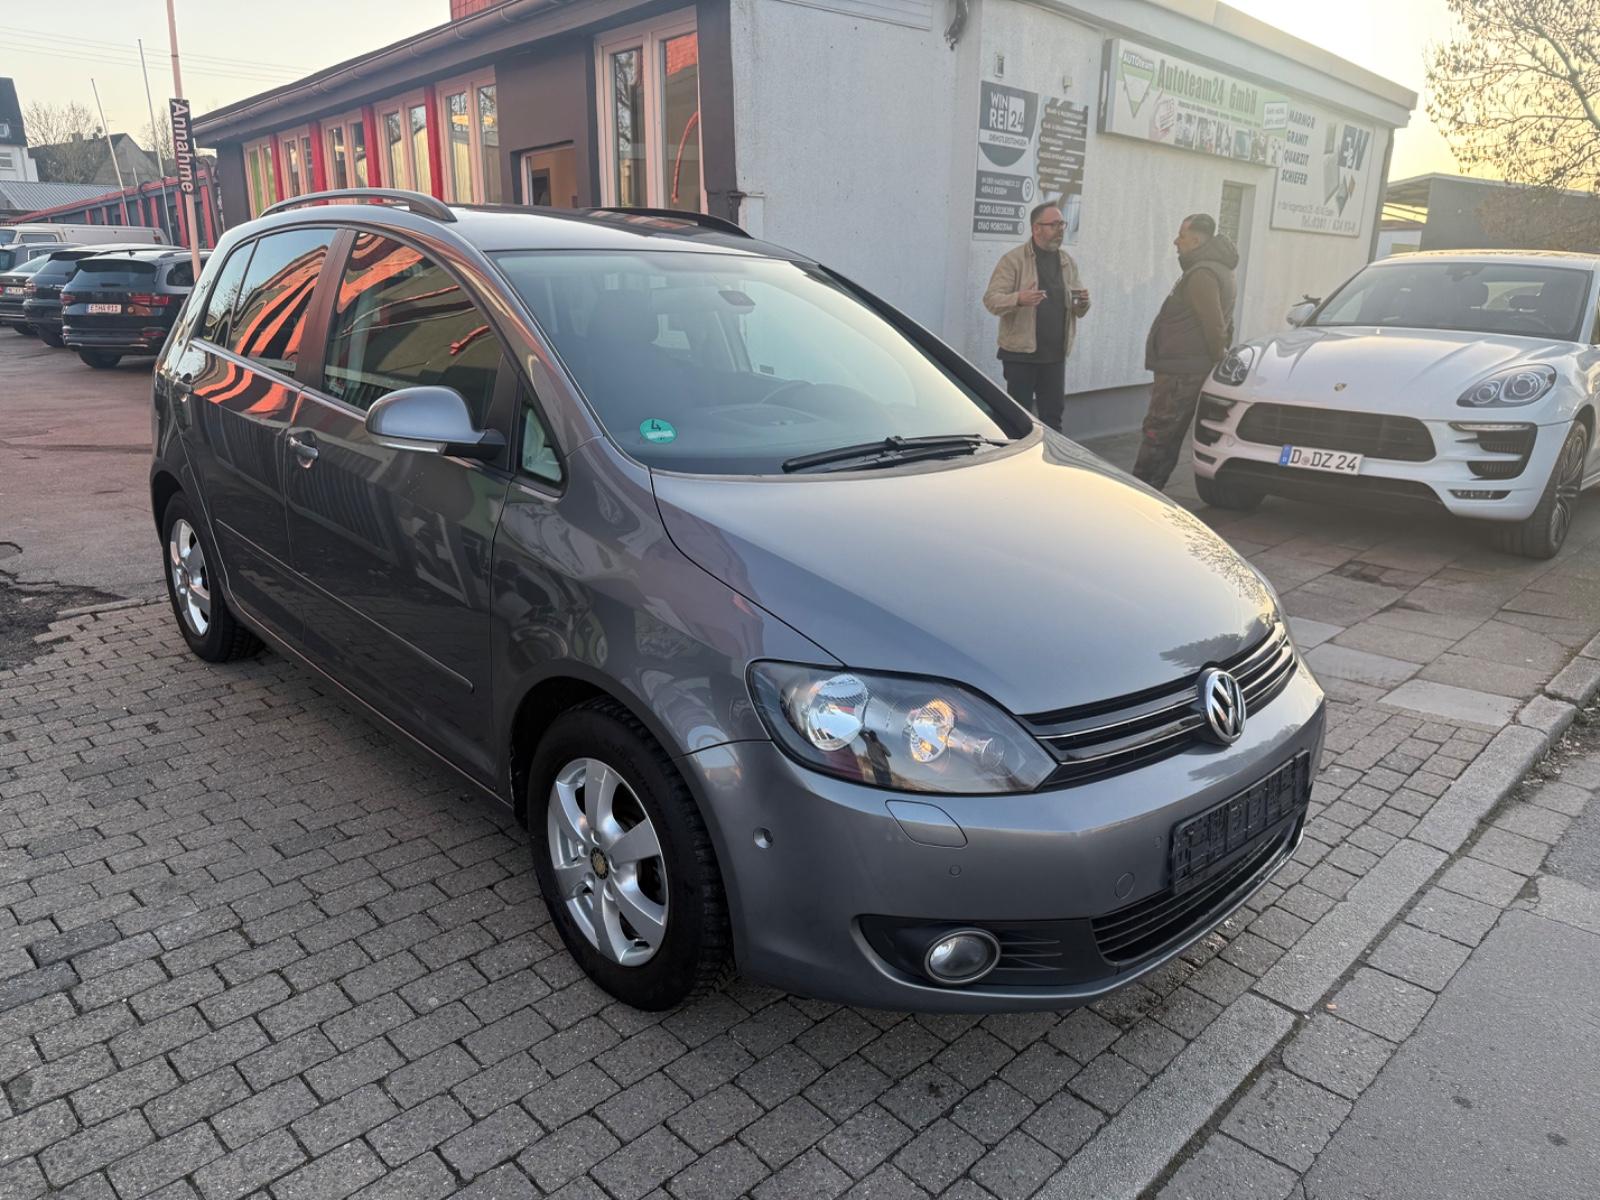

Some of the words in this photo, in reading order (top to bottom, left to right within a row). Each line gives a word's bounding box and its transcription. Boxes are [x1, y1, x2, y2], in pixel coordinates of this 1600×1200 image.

[1157, 59, 1225, 105] Autoteam24
[1229, 83, 1258, 115] GmbH
[991, 92, 1008, 110] WIN
[989, 108, 1008, 131] REI
[172, 101, 194, 192] Annahme
[1281, 169, 1308, 185] SCHIEFER
[1291, 449, 1302, 464] D
[1310, 452, 1333, 468] DZ
[1335, 455, 1357, 471] 24
